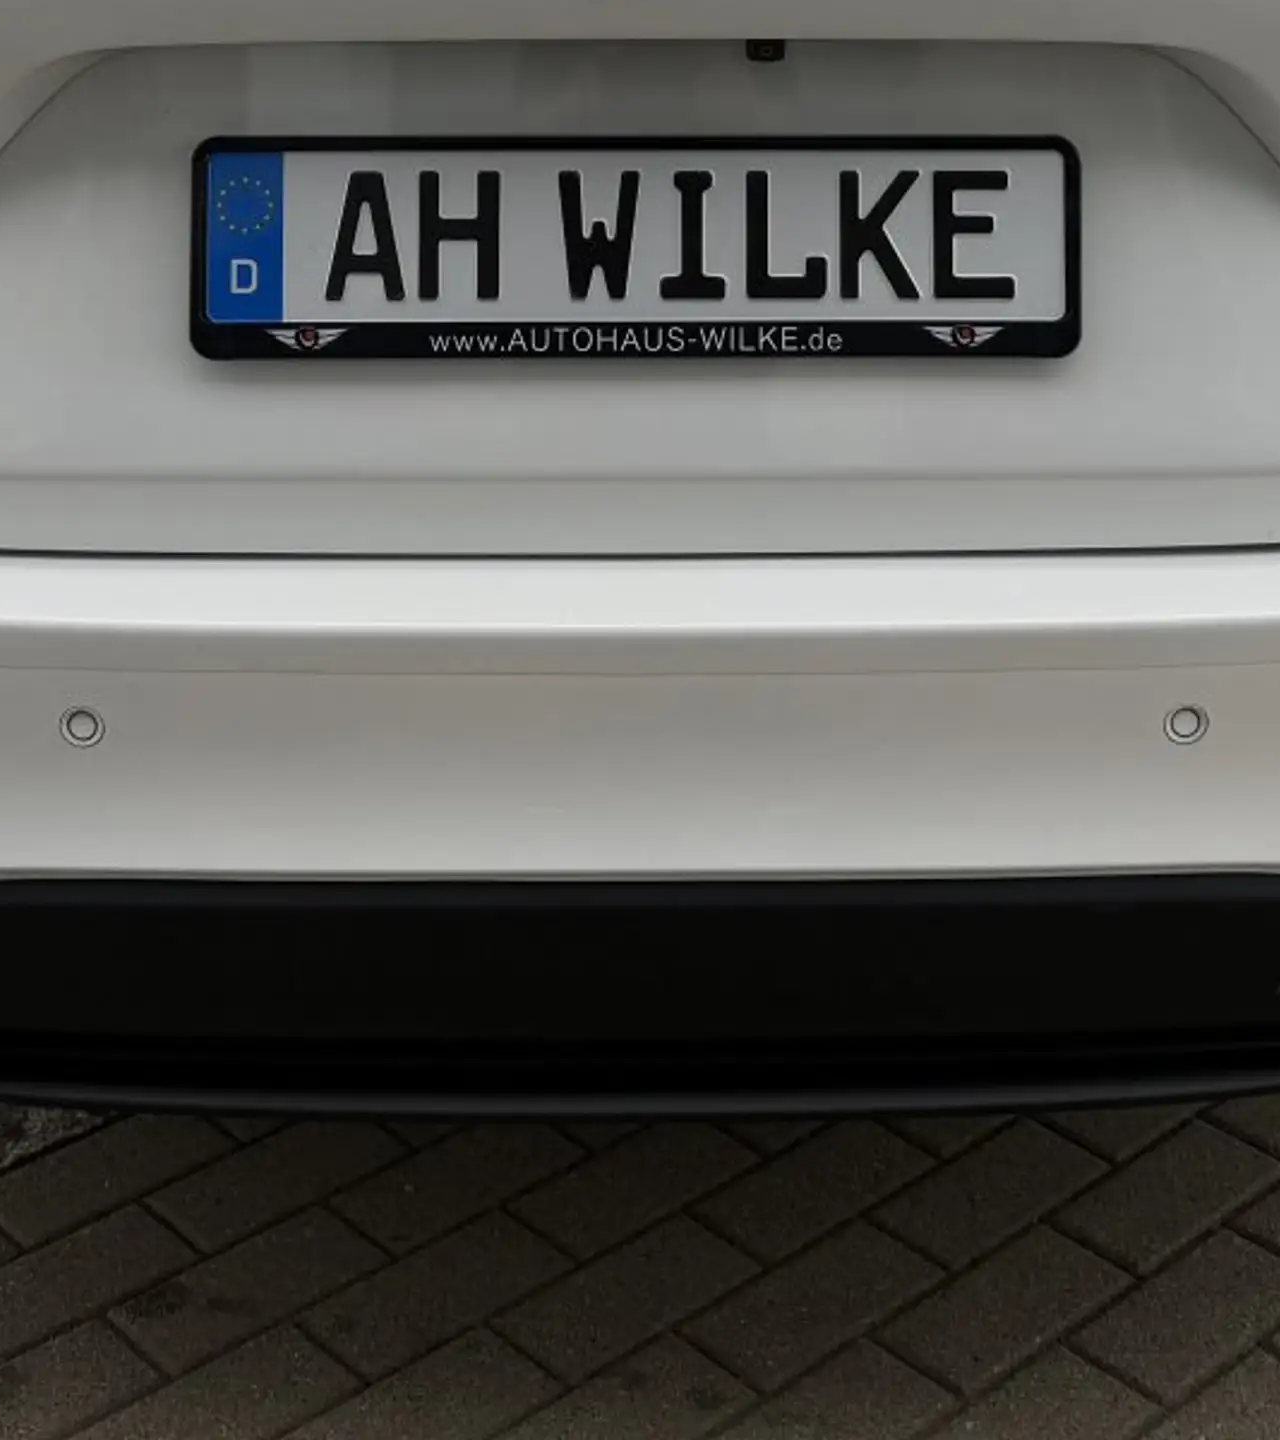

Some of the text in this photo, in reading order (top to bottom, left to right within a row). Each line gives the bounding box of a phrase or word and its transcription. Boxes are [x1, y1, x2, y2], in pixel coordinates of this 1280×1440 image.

[325, 171, 1015, 300] AH WILKE
[229, 257, 259, 295] D
[429, 327, 844, 353] www.AUTOHAUS-WILKE.de
